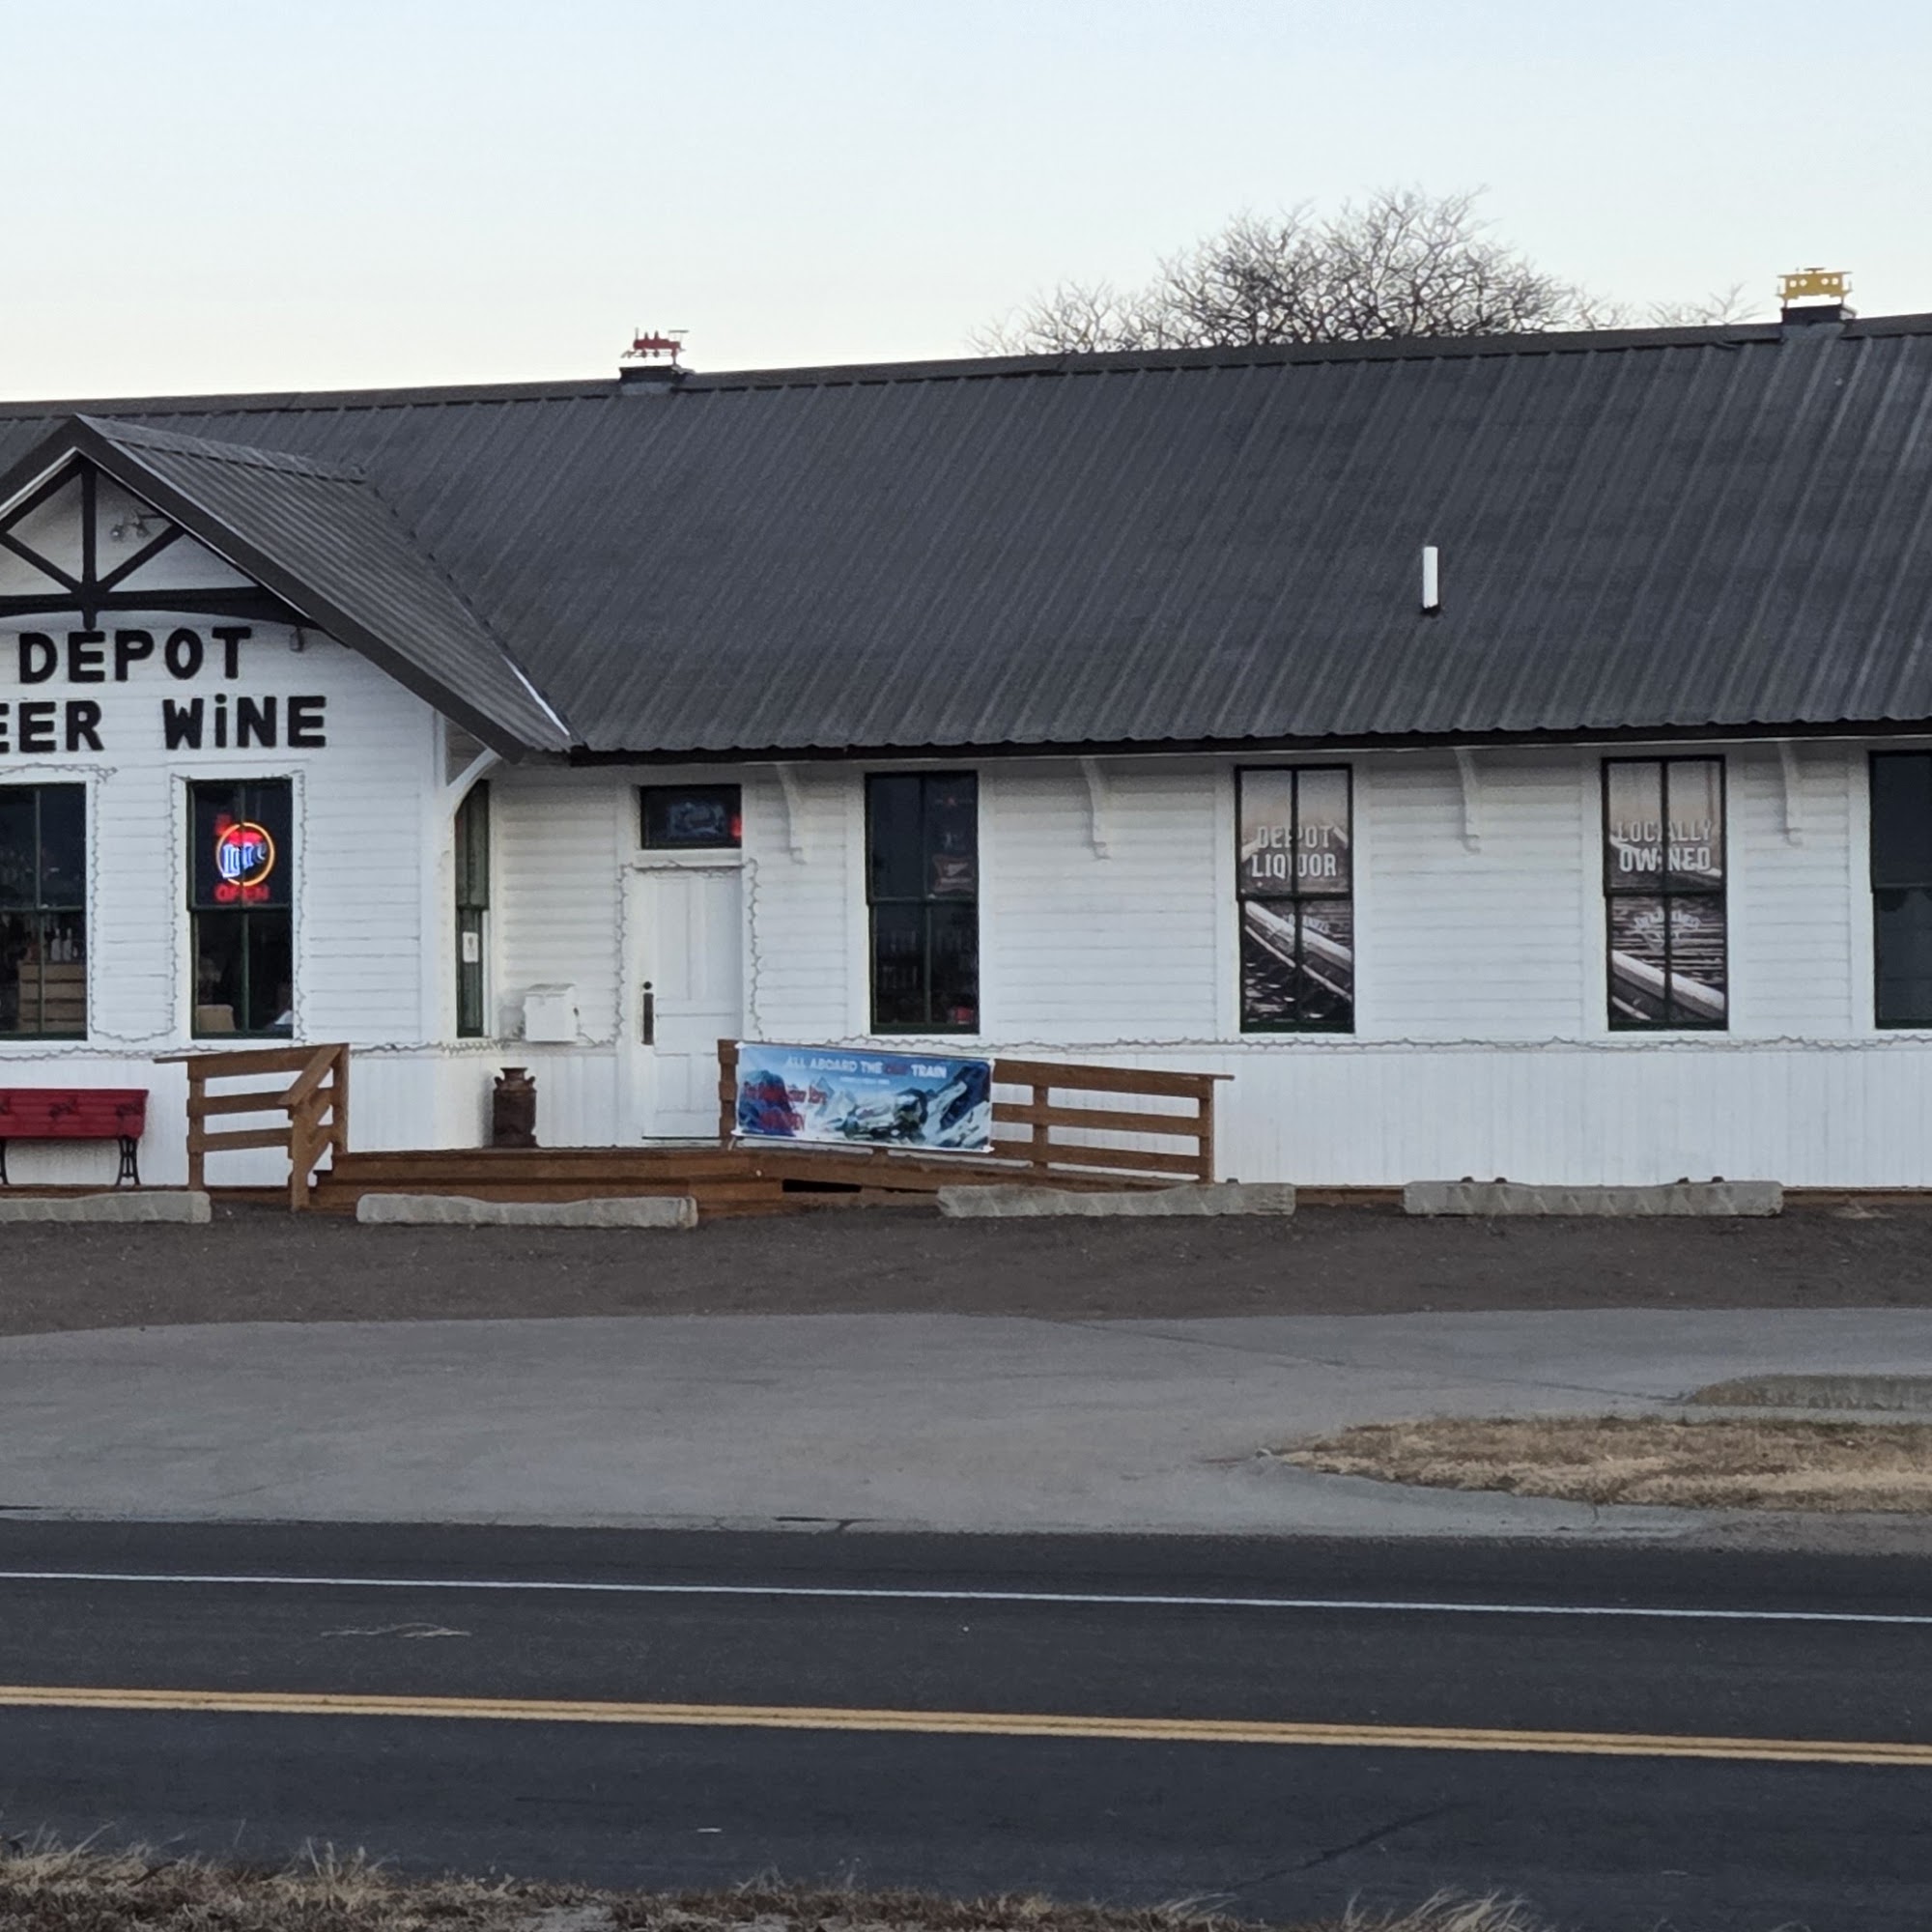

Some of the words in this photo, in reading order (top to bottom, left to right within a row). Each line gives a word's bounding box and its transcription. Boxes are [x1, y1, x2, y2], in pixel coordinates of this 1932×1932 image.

[18, 626, 252, 683] DEPOT
[0, 699, 104, 753] ER
[1258, 825, 1333, 848] DEPOT
[1617, 819, 1712, 842] LOCALLY
[1251, 853, 1337, 880] LIQUOR
[1619, 846, 1711, 872] OWNED
[860, 1060, 884, 1075] THE
[910, 1064, 948, 1079] TRAIN
